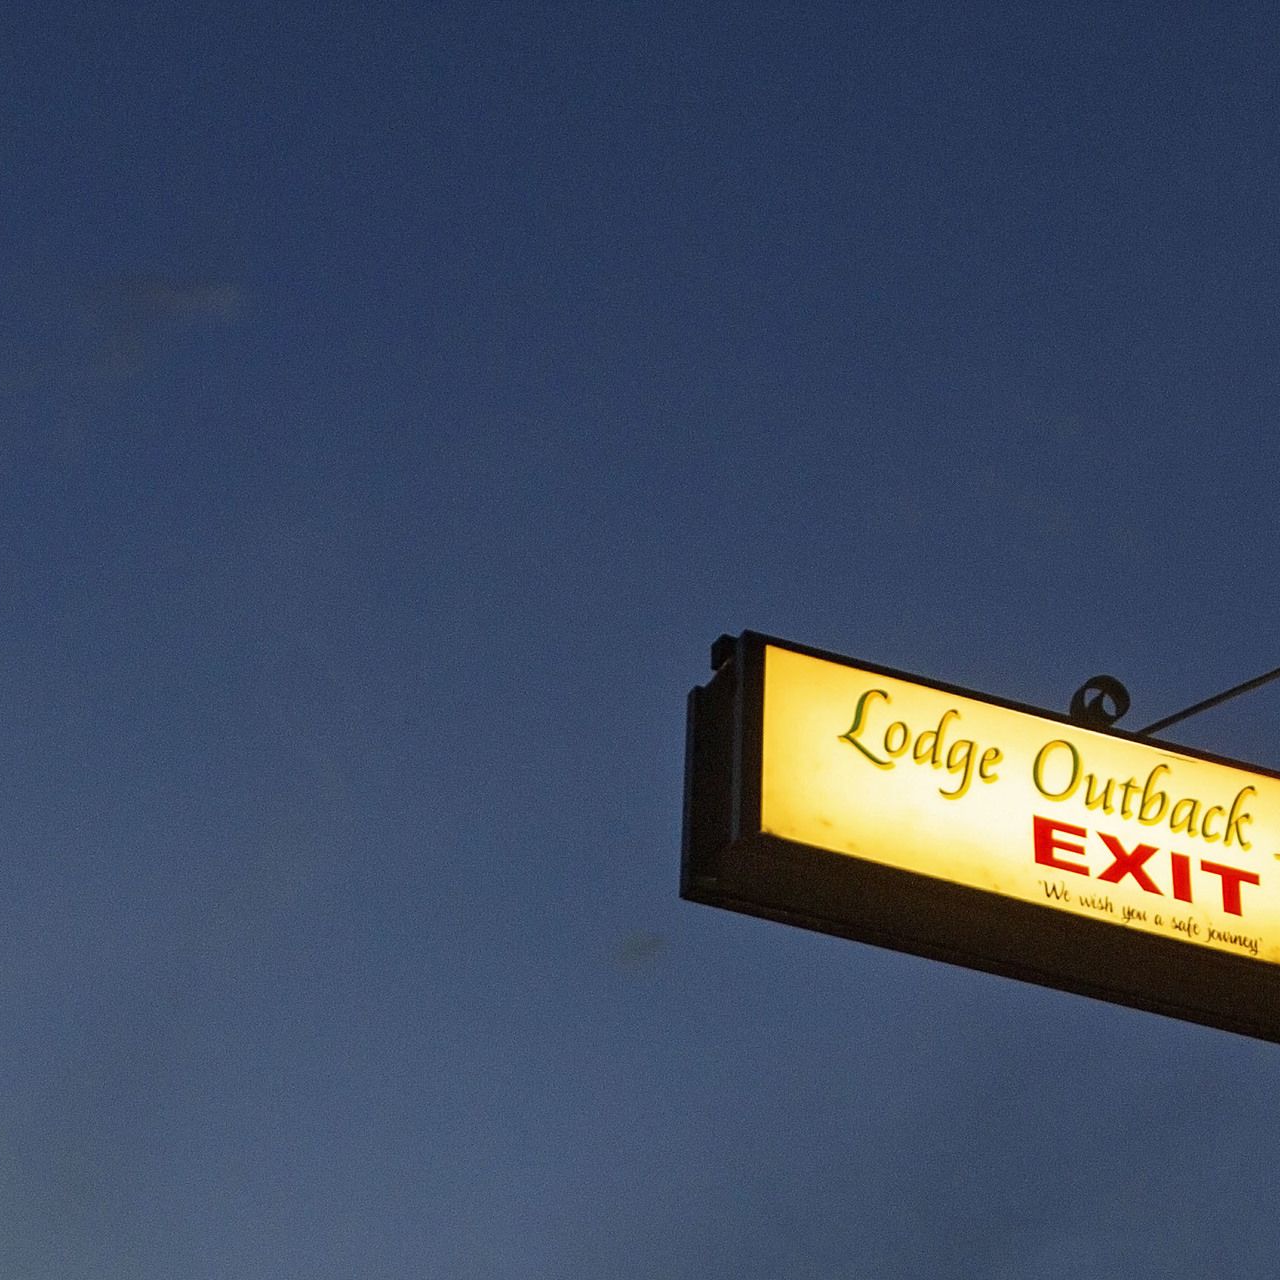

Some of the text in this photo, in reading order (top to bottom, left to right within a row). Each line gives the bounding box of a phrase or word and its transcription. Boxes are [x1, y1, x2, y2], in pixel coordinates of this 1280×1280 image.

[837, 688, 1003, 800] Lodge
[1032, 739, 1258, 851] Outback
[1033, 814, 1260, 917] EXIT
[1079, 894, 1114, 913] wish
[1121, 906, 1148, 924] you
[1154, 914, 1163, 926] a
[1172, 916, 1200, 938] safe
